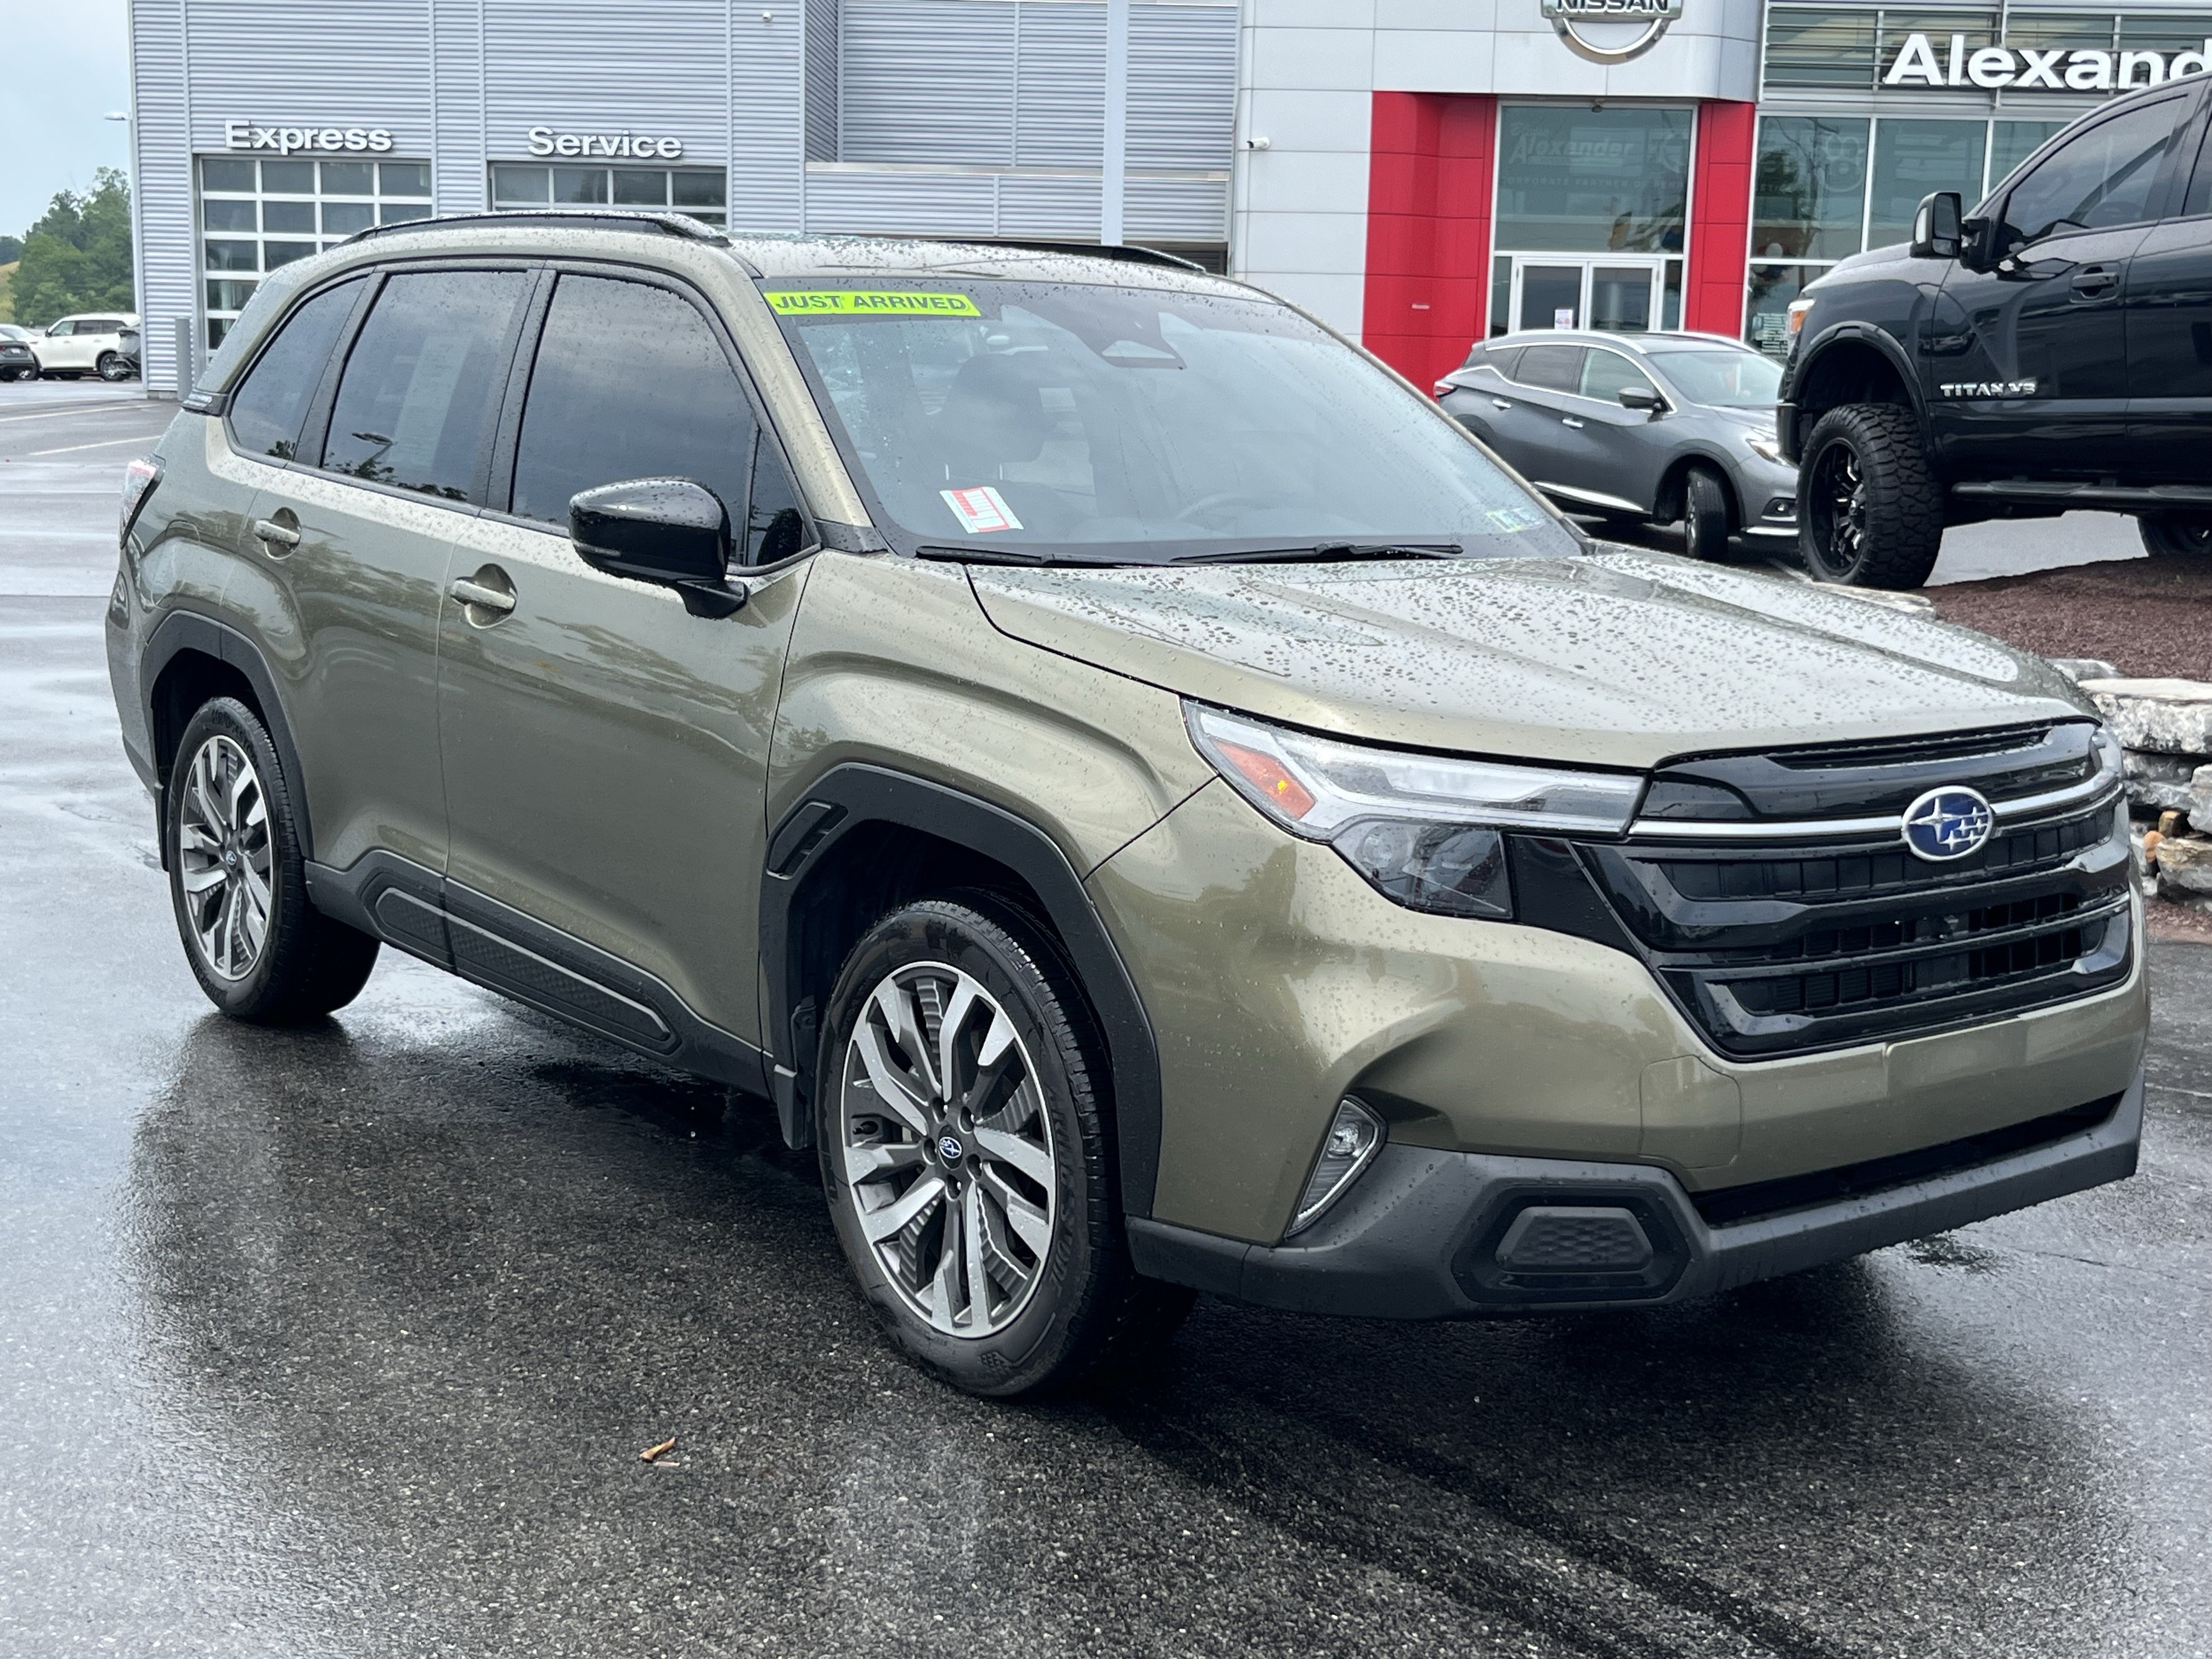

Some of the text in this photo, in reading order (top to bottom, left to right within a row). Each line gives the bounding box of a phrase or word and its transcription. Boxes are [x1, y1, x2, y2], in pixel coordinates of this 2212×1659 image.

[1556, 0, 1670, 13] NISSAN
[225, 120, 392, 156] Express
[527, 126, 683, 158] Service
[775, 295, 969, 311] JUST ARRIVED
[1940, 383, 2004, 397] TITAN
